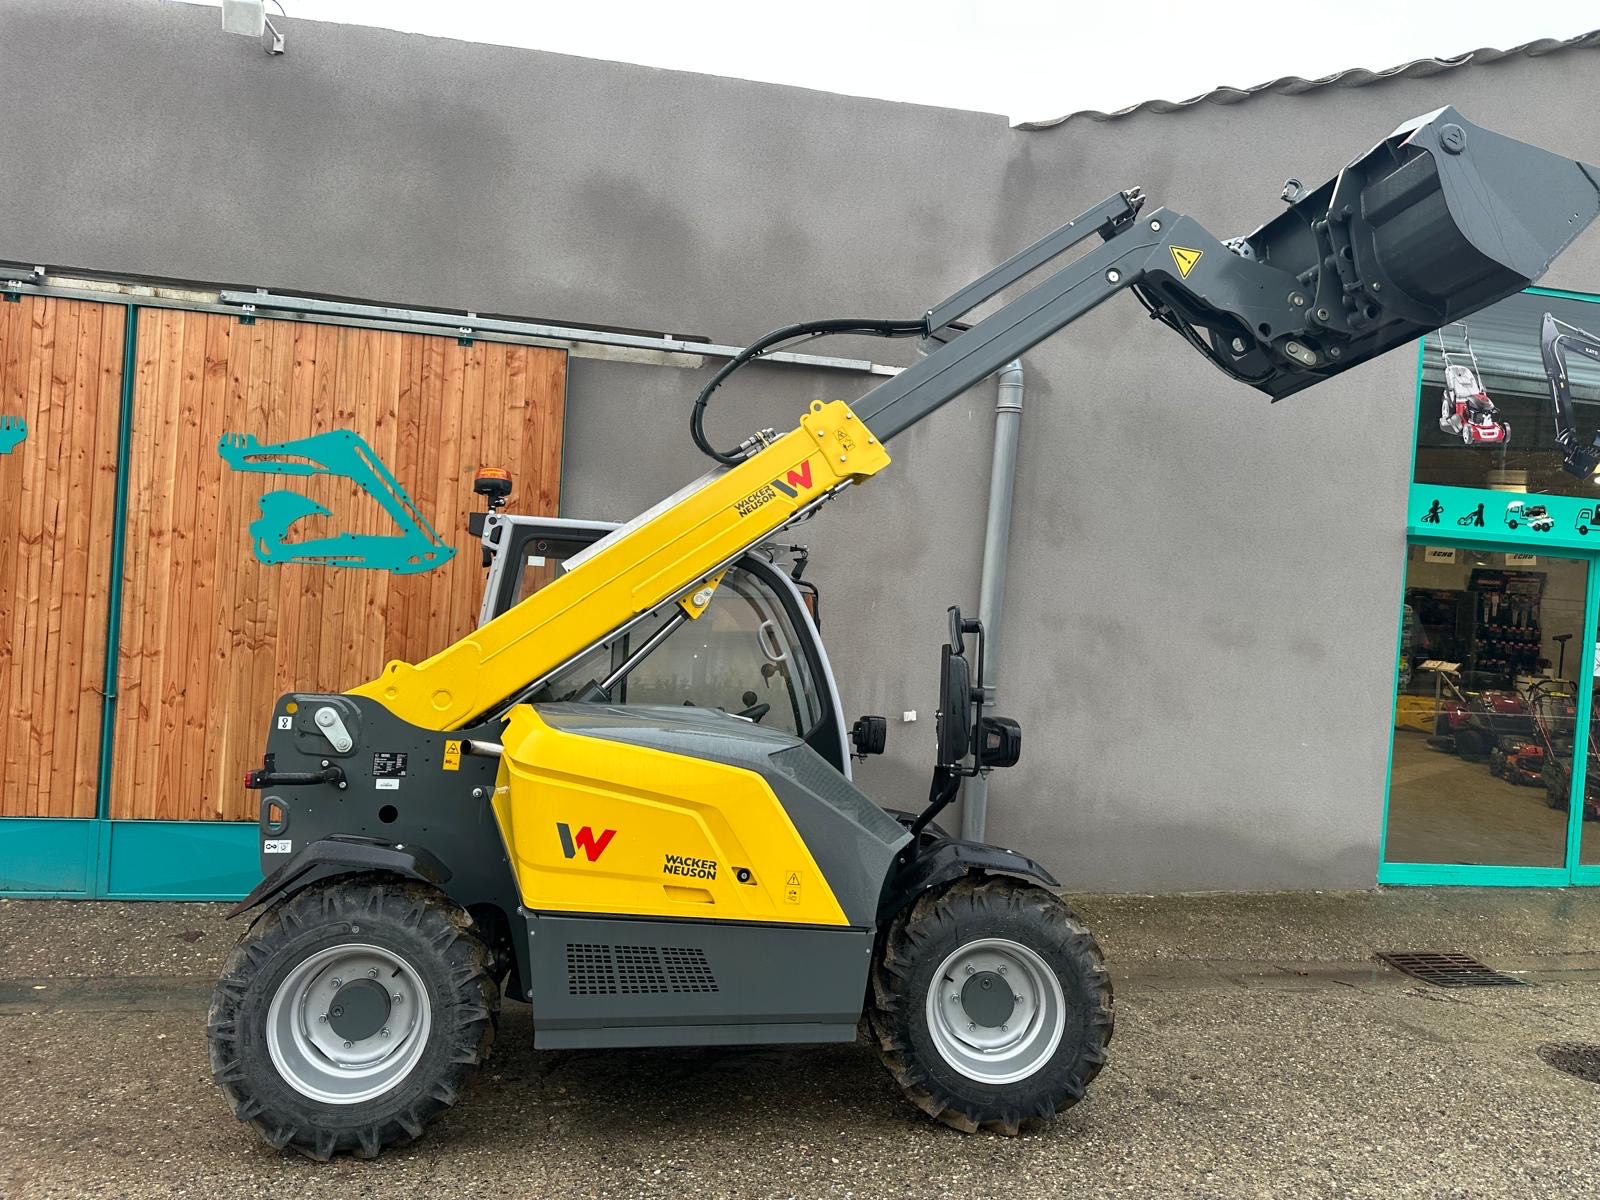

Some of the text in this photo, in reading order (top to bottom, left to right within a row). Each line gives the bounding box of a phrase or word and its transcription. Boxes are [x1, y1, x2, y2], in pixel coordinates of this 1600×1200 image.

[734, 485, 772, 510] WACKER
[739, 491, 777, 517] NEUSON
[1432, 550, 1454, 558] ECHO
[665, 854, 717, 870] WACKER
[663, 864, 716, 880] NEUSON
